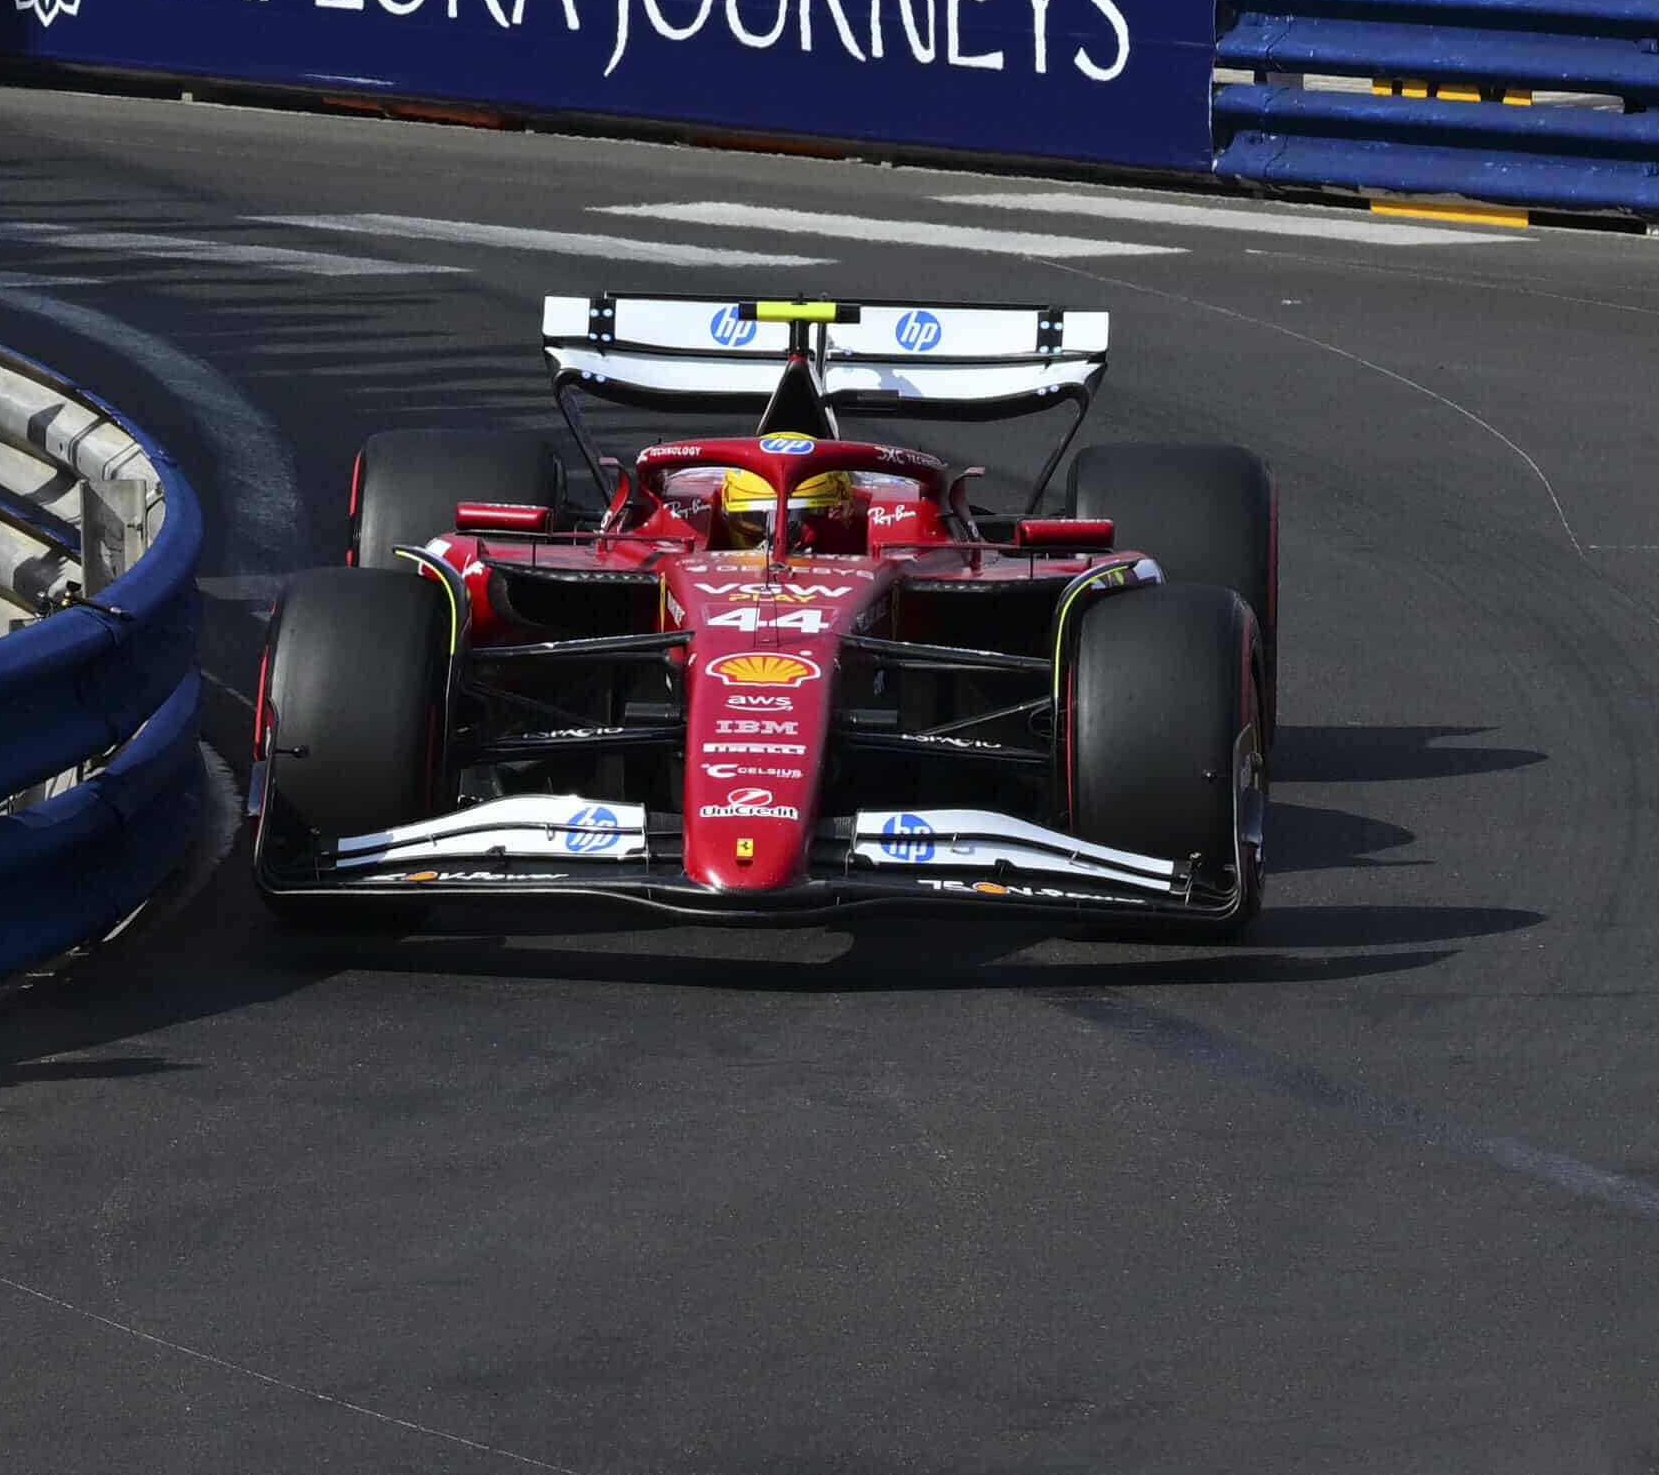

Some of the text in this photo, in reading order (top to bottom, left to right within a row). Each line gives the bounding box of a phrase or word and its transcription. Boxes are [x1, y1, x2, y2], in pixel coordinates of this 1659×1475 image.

[715, 306, 754, 347] hp
[902, 310, 939, 352] hp
[769, 438, 806, 453] hp
[867, 504, 917, 526] Ray-Ban
[693, 583, 853, 598] VGW
[728, 594, 819, 602] PLAY
[707, 607, 830, 634] 44
[715, 720, 799, 735] IBM
[702, 743, 807, 755] PIRELLI
[737, 766, 803, 778] CELSIUS
[700, 805, 799, 822] UniCredit
[570, 807, 617, 849] hp
[887, 814, 933, 862] hp
